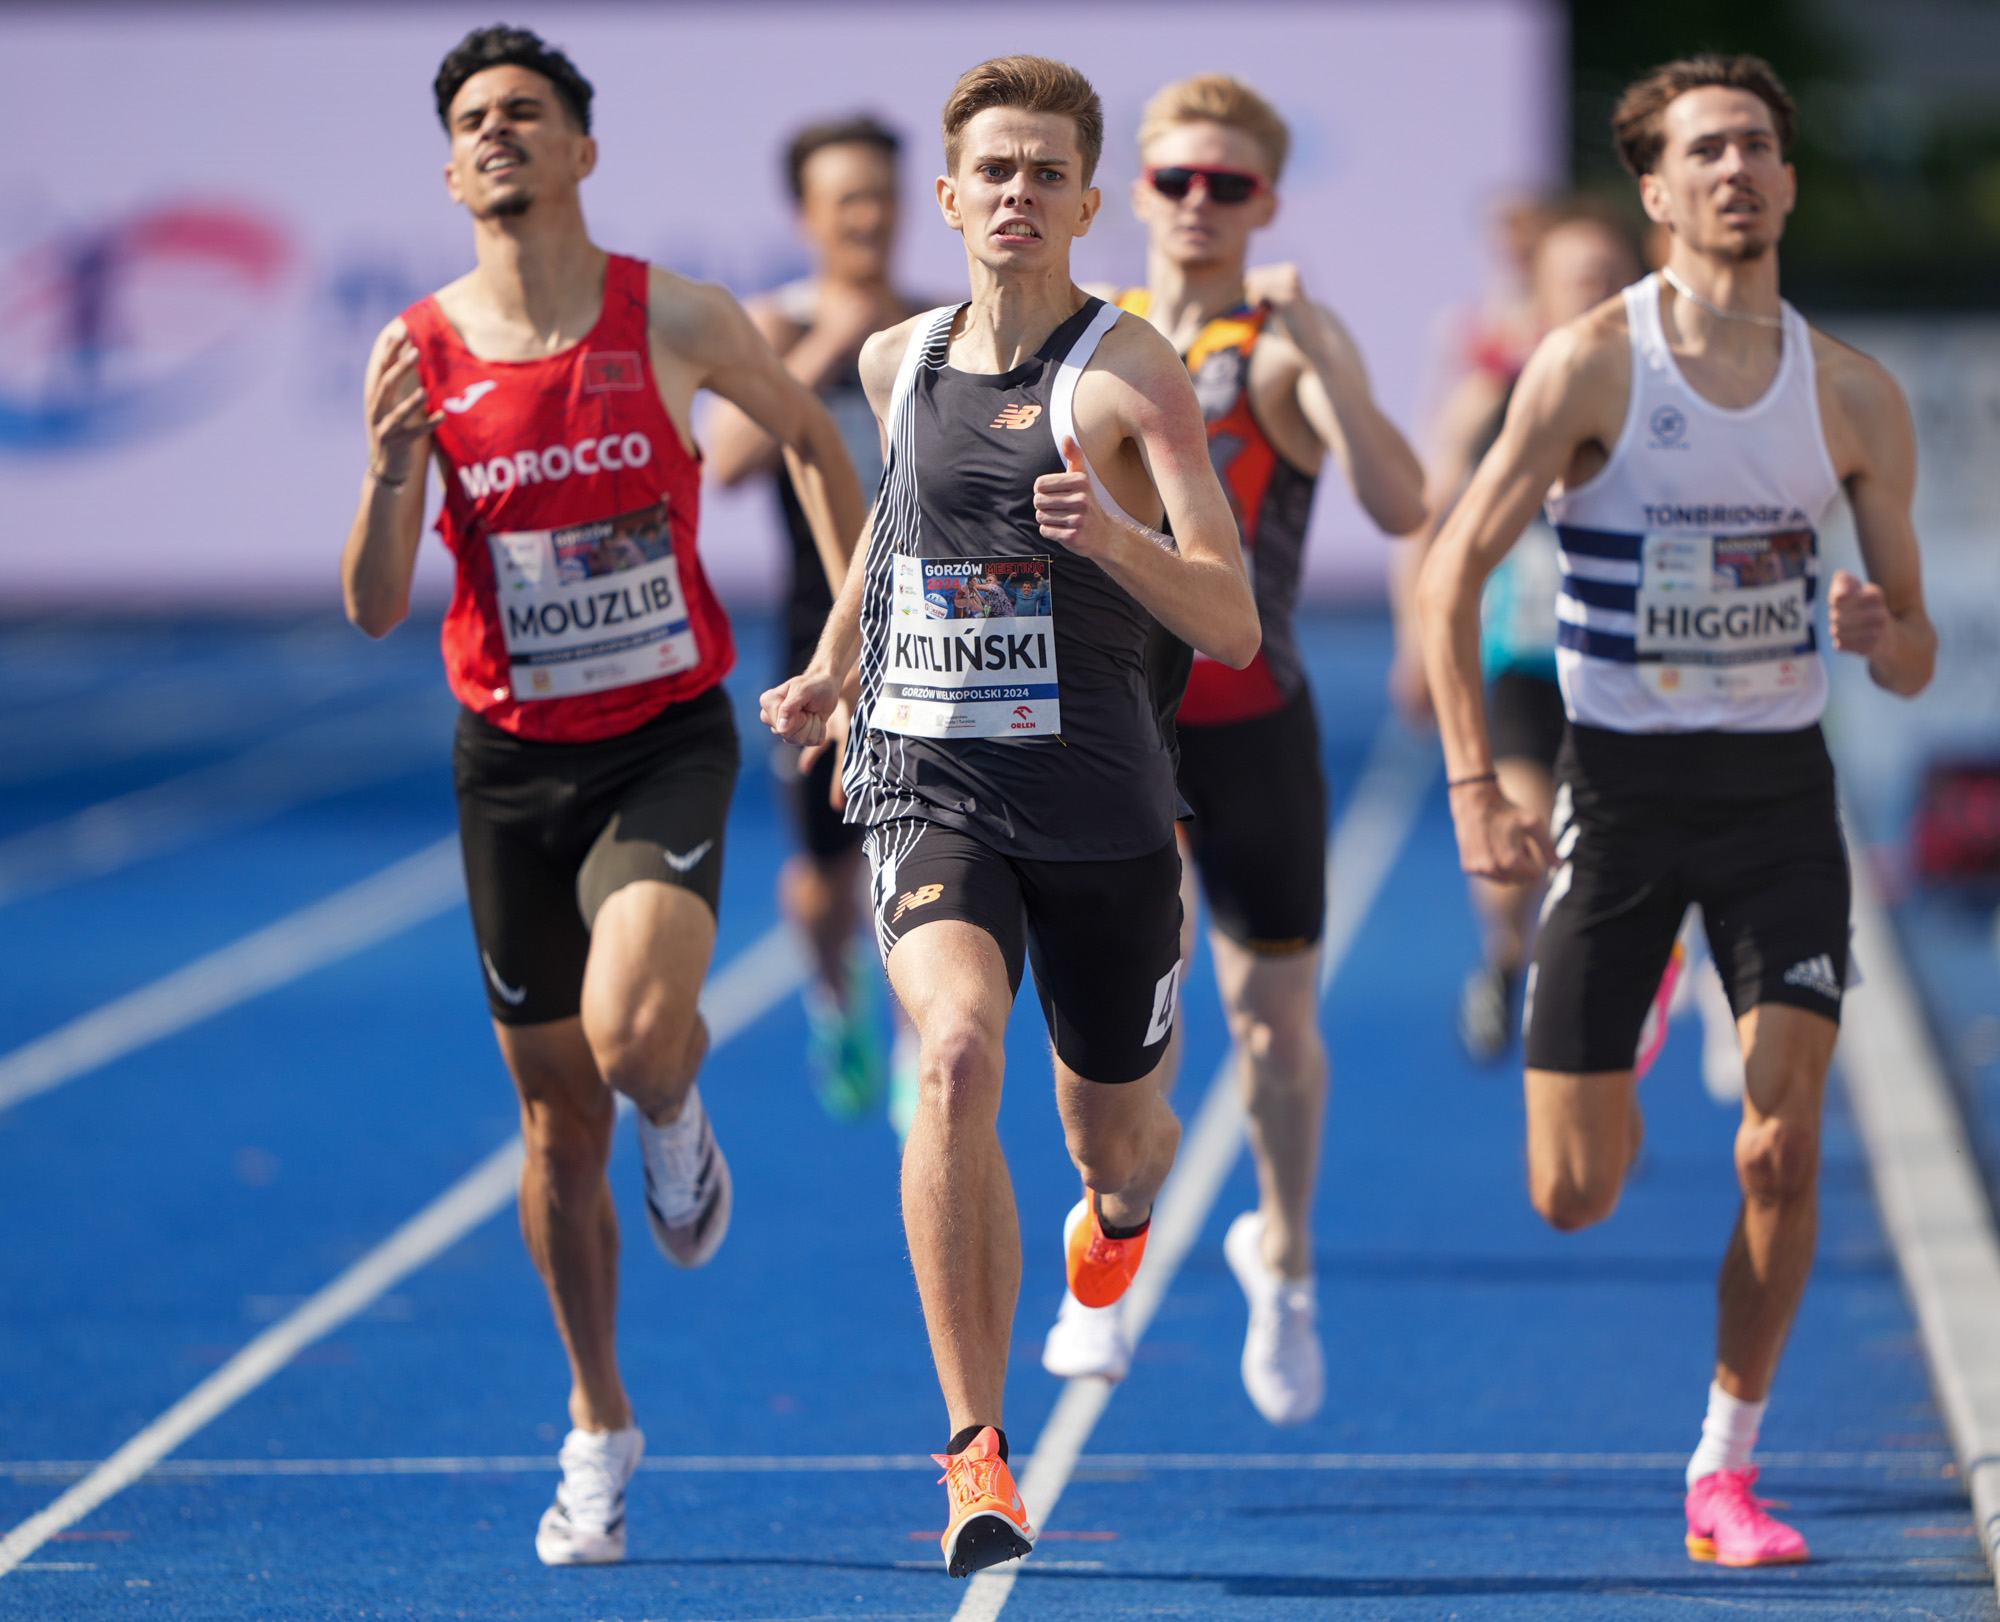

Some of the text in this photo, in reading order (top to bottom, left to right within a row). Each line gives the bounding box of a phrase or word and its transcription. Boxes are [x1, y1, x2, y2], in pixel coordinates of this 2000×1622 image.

[458, 431, 652, 499] MOROCCO
[1644, 504, 1783, 526] TONBRIDGE
[925, 561, 982, 577] GORZÓW
[985, 562, 1046, 575] MEETING
[927, 578, 961, 590] 2024
[508, 576, 673, 641] MOUZLIB
[1646, 595, 1802, 640] HIGGINS
[895, 628, 1048, 672] KITLIŃSKI
[901, 687, 936, 699] GORZÓW
[1003, 688, 1030, 698] 2024
[1157, 971, 1175, 1029] 4
